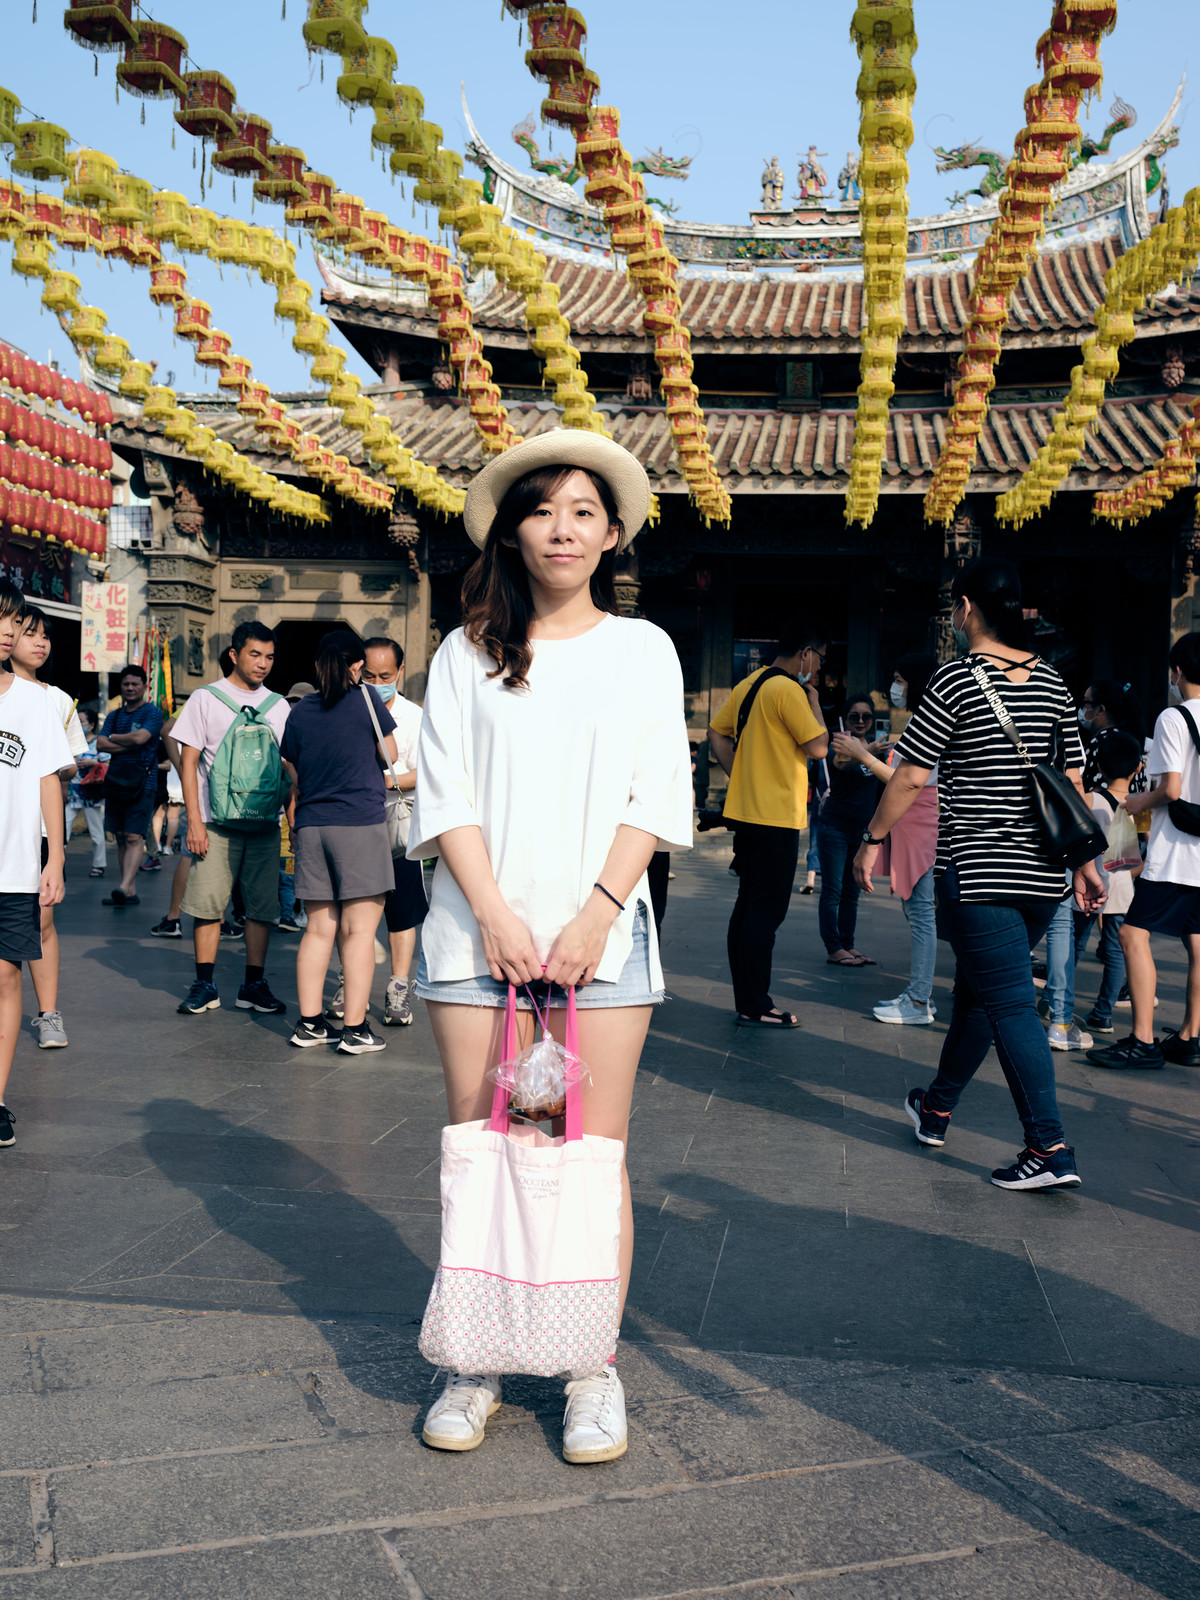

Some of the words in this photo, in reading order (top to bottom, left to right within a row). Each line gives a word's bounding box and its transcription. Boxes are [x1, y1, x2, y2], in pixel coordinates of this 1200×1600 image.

[85, 594, 95, 602] 2F
[105, 585, 127, 652] 化粧室
[85, 628, 95, 637] 1F
[970, 665, 993, 690] PARIS
